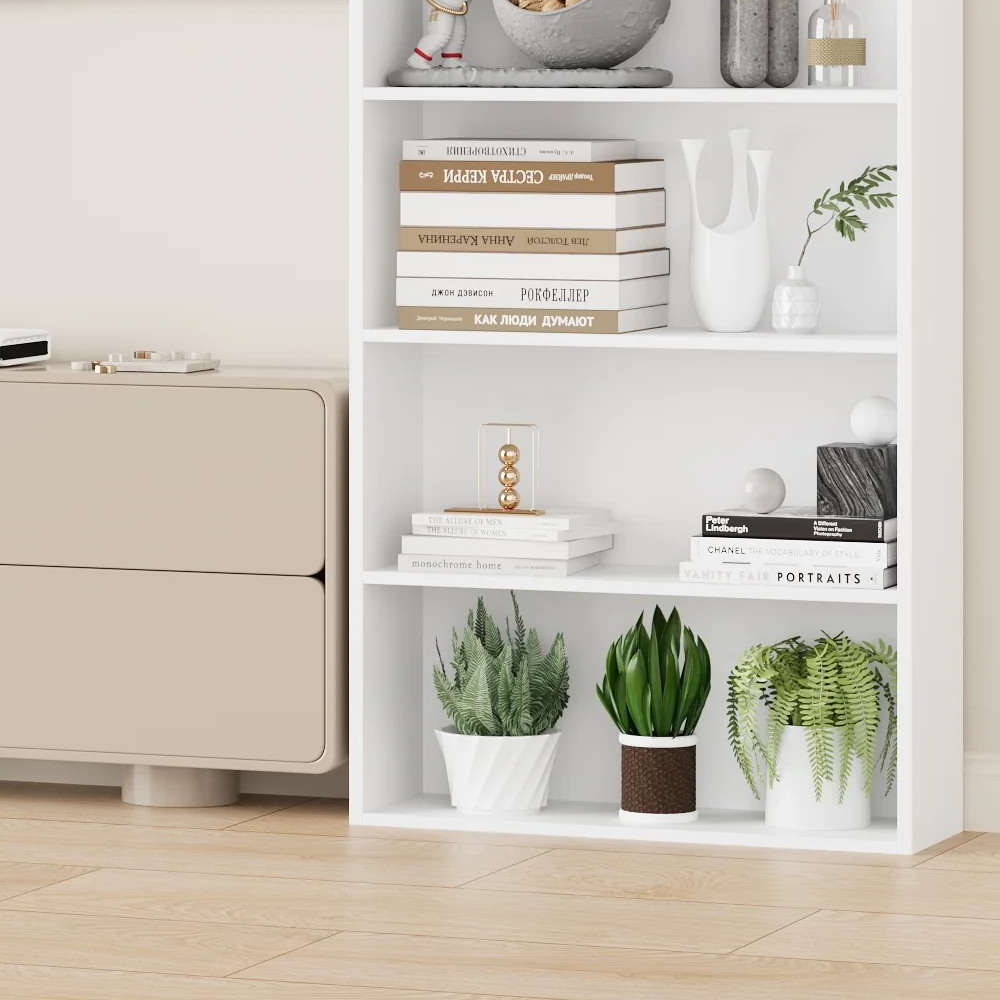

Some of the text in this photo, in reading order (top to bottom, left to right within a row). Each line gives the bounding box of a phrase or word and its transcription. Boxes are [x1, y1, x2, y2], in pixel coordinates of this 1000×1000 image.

[446, 146, 526, 156] СТИХОТВОРЕНИЯ
[443, 169, 487, 184] КЕРРИ
[491, 169, 544, 184] СЕСТРА
[432, 287, 590, 303] ДЖОН ДЭВИСОН РОКФЕЛЛЕР
[474, 314, 497, 325] КАК
[500, 314, 536, 327] ЛЮДИ
[541, 315, 594, 328] ДУМАЮТ
[428, 516, 442, 524] THE
[486, 518, 503, 526] MEN
[706, 516, 729, 525] Peter
[427, 526, 441, 534] THE
[480, 529, 507, 537] WOMEN
[706, 524, 749, 534] Lindbergh
[708, 546, 746, 555] CHANEL
[765, 548, 820, 557] VOCABULARY
[822, 549, 833, 557] OF
[834, 550, 859, 559] STYLE
[412, 560, 502, 570] monochrome home
[777, 572, 861, 584] PORTRAITS
